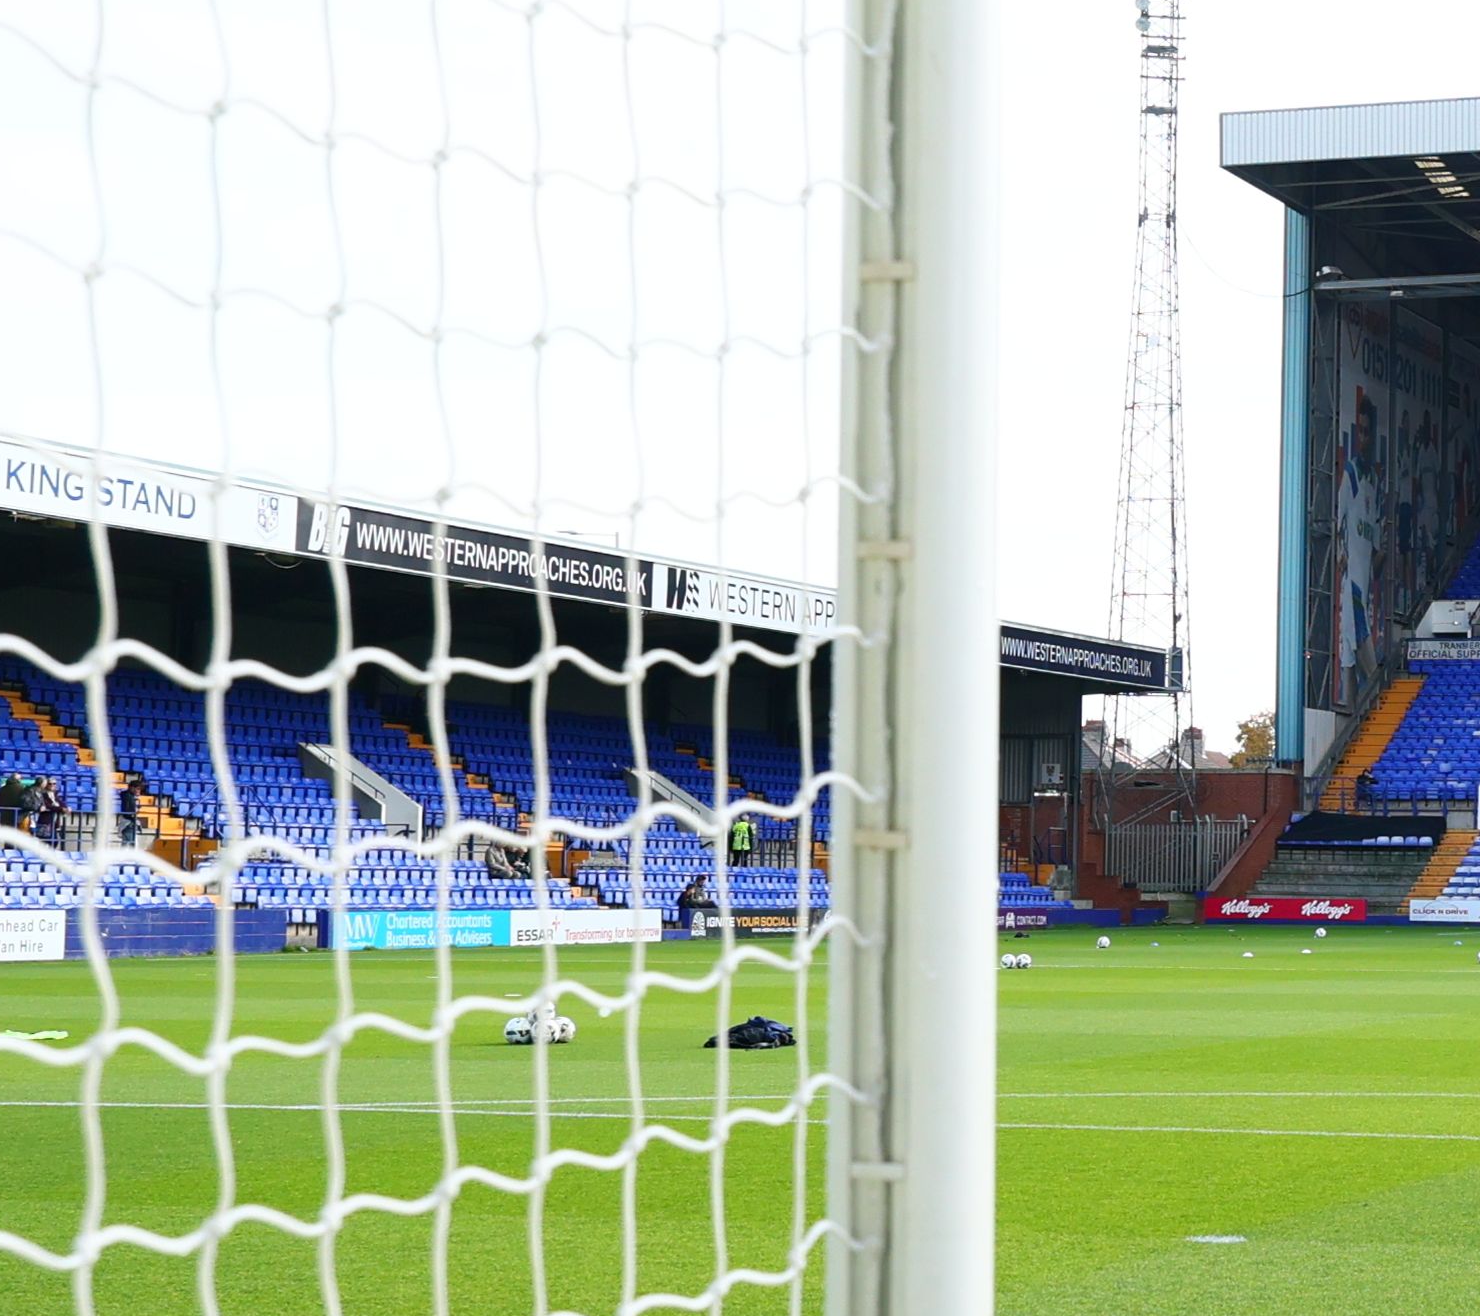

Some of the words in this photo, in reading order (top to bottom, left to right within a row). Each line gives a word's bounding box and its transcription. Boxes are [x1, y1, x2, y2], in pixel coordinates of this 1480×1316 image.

[7, 460, 85, 503] KING
[97, 477, 197, 521] STAND
[356, 521, 647, 596] WWW.WESTERNAPPROACHES.ORG.UK
[709, 579, 796, 624] WESTERN
[1001, 636, 1152, 678] WWW.WESTERNAPPROACHES.ORG.UK
[1408, 649, 1454, 659] OFFICIAL
[1221, 899, 1272, 918] Kellogg's
[1301, 899, 1352, 919] Kellogg's
[38, 919, 59, 933] Car
[386, 913, 433, 929] Chartered
[386, 931, 426, 946] Business
[516, 929, 554, 942] ESSAR
[565, 928, 613, 942] Transforming
[20, 939, 44, 953] Hire
